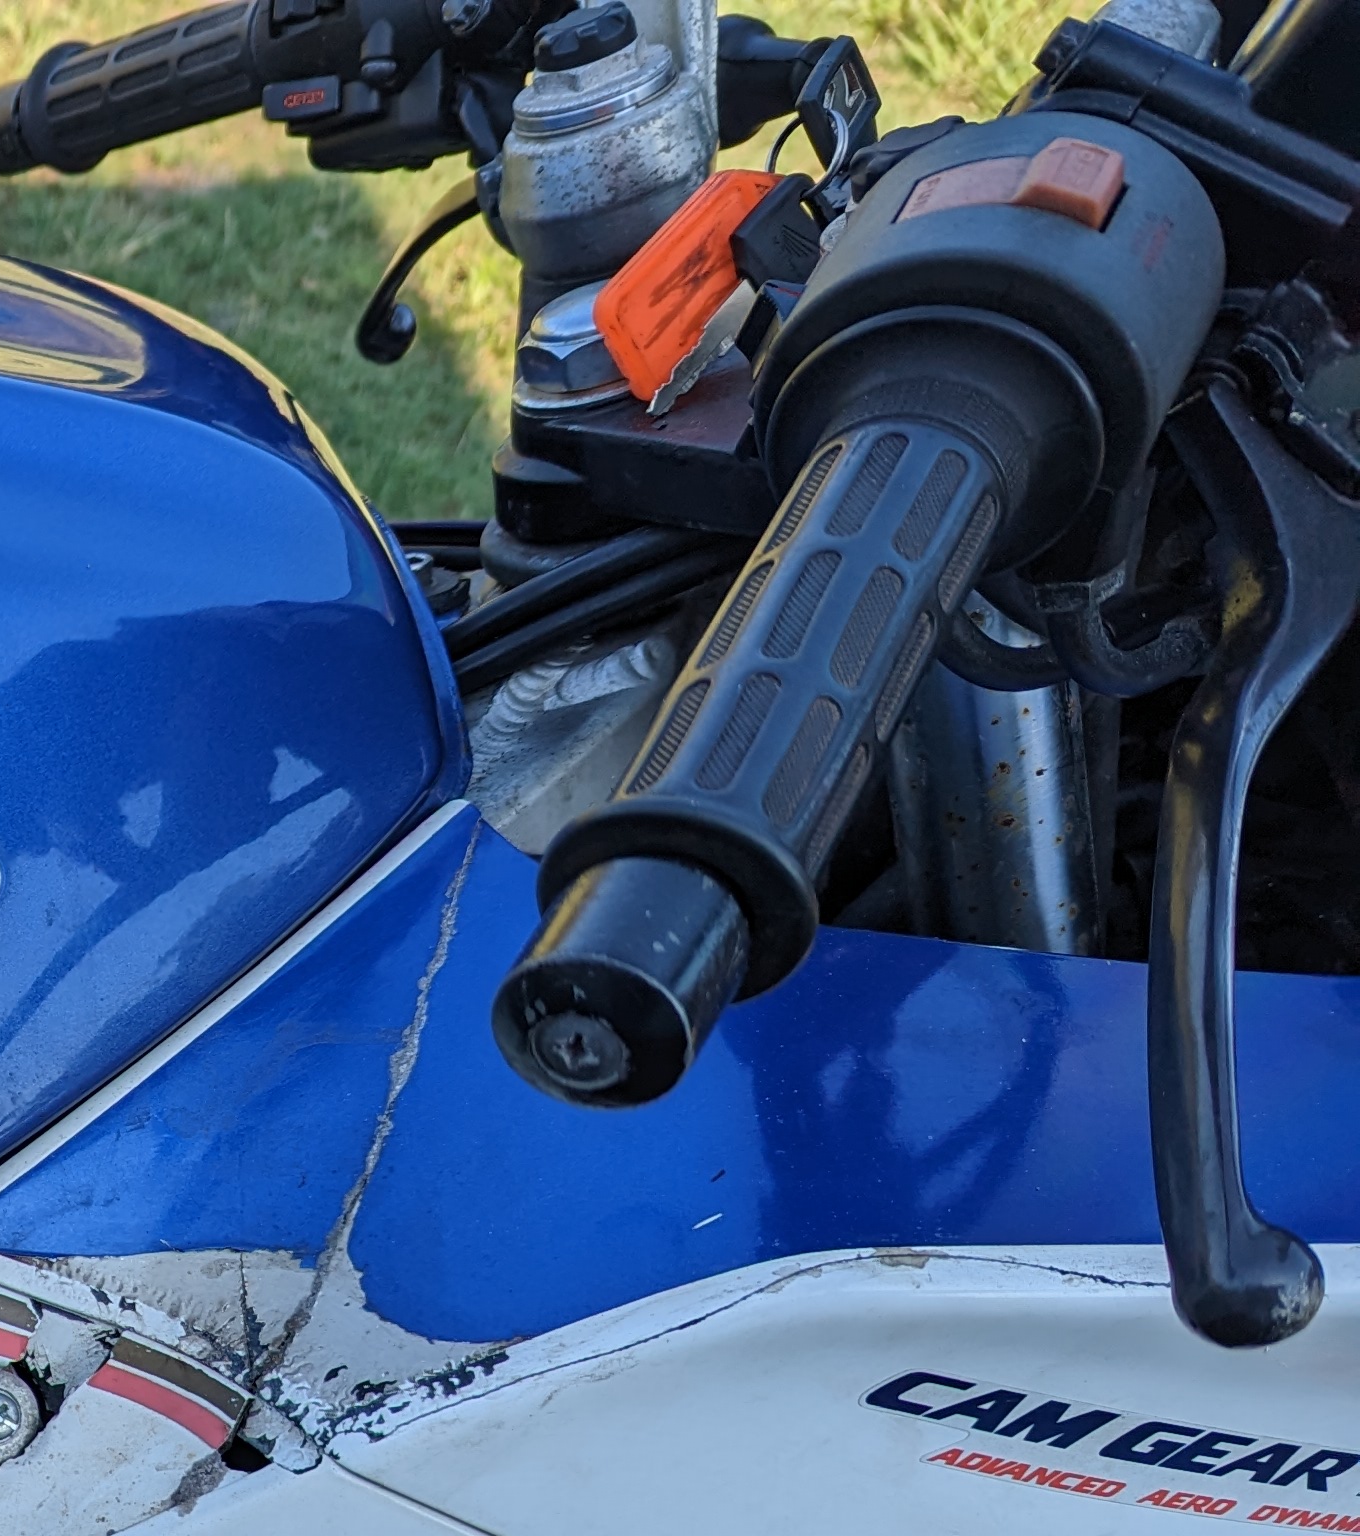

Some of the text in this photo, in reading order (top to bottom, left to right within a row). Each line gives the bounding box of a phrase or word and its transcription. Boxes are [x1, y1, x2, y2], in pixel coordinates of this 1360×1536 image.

[864, 1370, 1360, 1493] CAM GEAR
[925, 1448, 1127, 1498] ADVANCED
[1135, 1488, 1238, 1516] AERO
